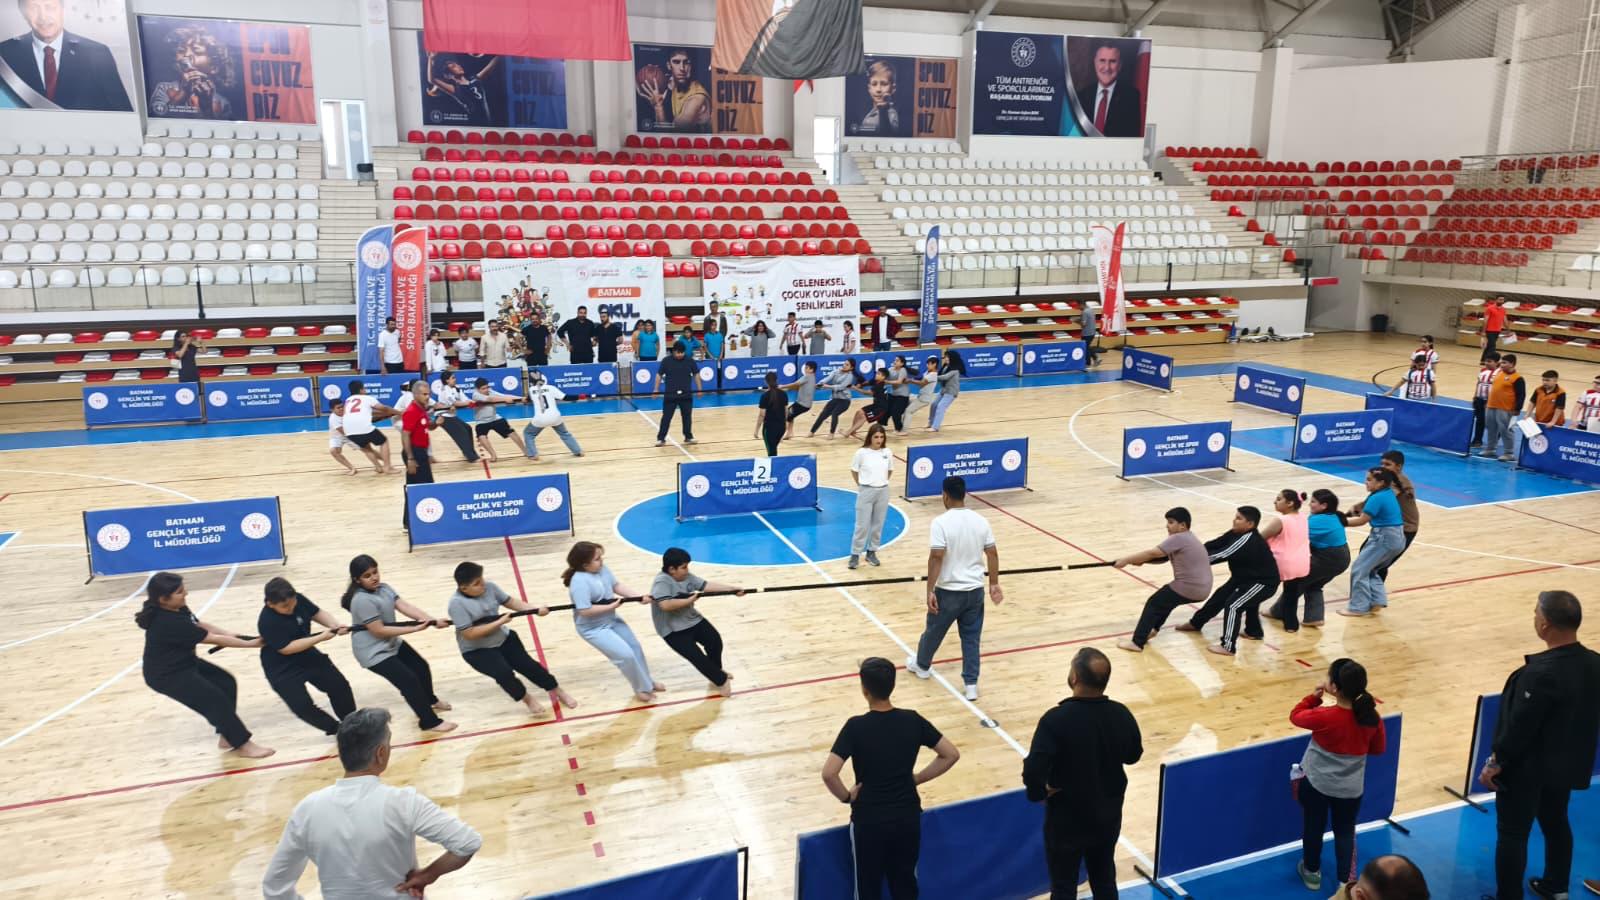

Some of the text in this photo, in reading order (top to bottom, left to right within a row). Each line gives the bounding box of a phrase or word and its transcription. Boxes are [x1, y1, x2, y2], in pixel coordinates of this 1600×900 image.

[792, 278, 846, 287] GELENEKSEL
[598, 288, 632, 297] BATMAN
[781, 288, 857, 301] ÇOCUK OYUNLARI
[796, 299, 844, 312] ŞENLİKLERİ
[407, 325, 416, 350] SPOR
[351, 399, 361, 413] 2
[758, 465, 766, 479] 2
[473, 491, 506, 500] BATMAN
[457, 502, 490, 511] GENÇLİK
[503, 499, 524, 507] SPOR
[462, 508, 519, 520] İL MÜDÜRLÜĞÜ
[166, 517, 205, 526] BATMAN
[146, 525, 226, 538] GENÇLİK VE SPOR
[154, 534, 221, 548] İL MÜDÜRLÜĞÜ
